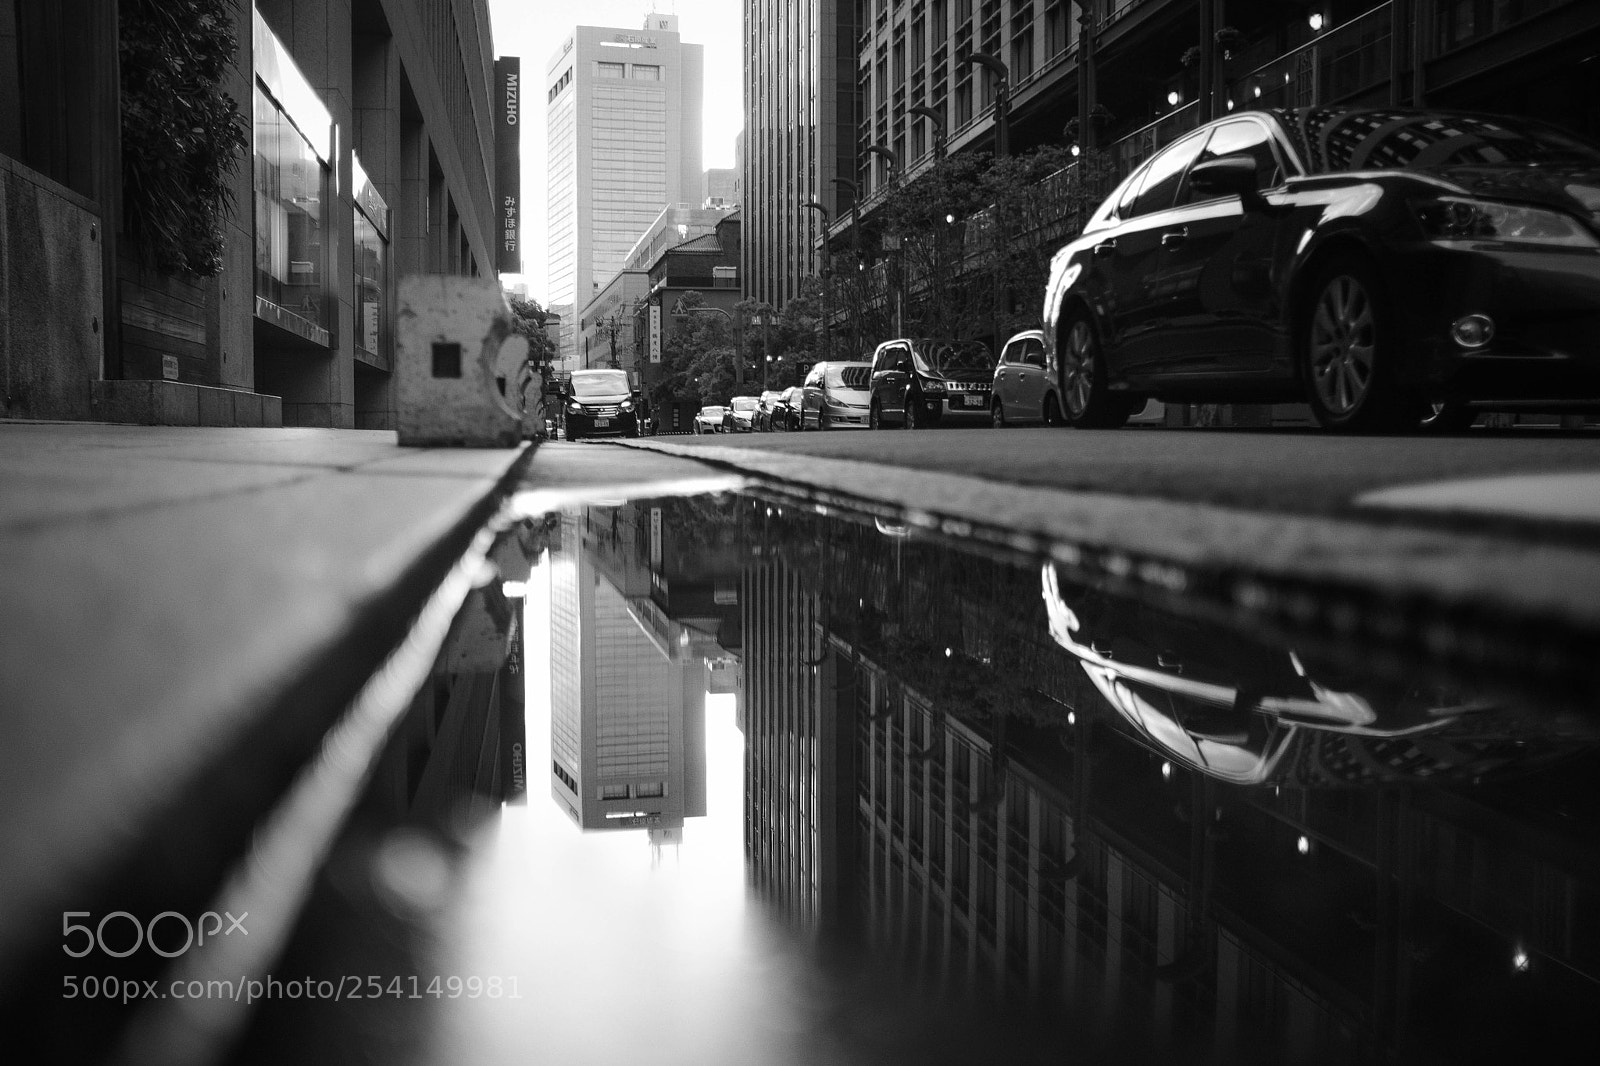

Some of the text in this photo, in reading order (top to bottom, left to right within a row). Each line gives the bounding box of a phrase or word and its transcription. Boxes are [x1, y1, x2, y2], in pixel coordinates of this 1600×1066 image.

[507, 73, 518, 126] MIZUHO
[504, 196, 517, 252] みずほ銀行
